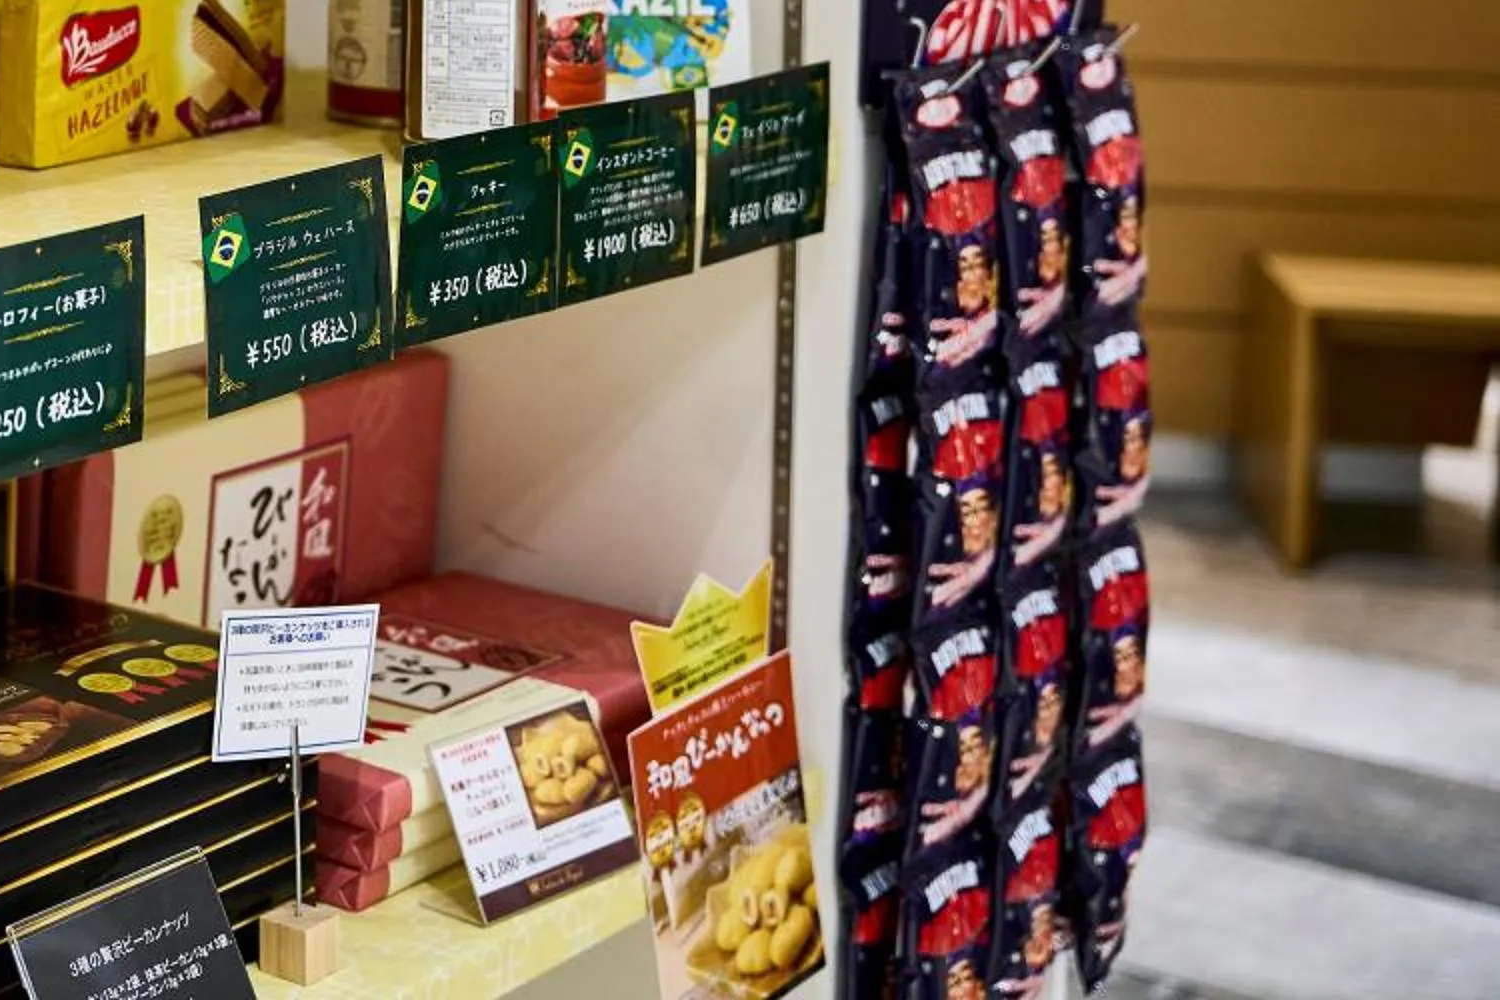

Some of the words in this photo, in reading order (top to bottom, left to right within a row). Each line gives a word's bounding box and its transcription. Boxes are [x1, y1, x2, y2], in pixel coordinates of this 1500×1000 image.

[67, 72, 149, 140] HAZELNUT
[596, 147, 676, 172] インスタントコーヒー
[254, 236, 297, 259] ブラジル
[584, 232, 626, 262] ¥1900
[631, 218, 675, 252] (税込)
[429, 276, 469, 306] ¥350
[476, 259, 527, 295] (税込)
[247, 333, 292, 369] ¥550
[301, 312, 357, 352] (税込)
[36, 381, 105, 429] (税込)
